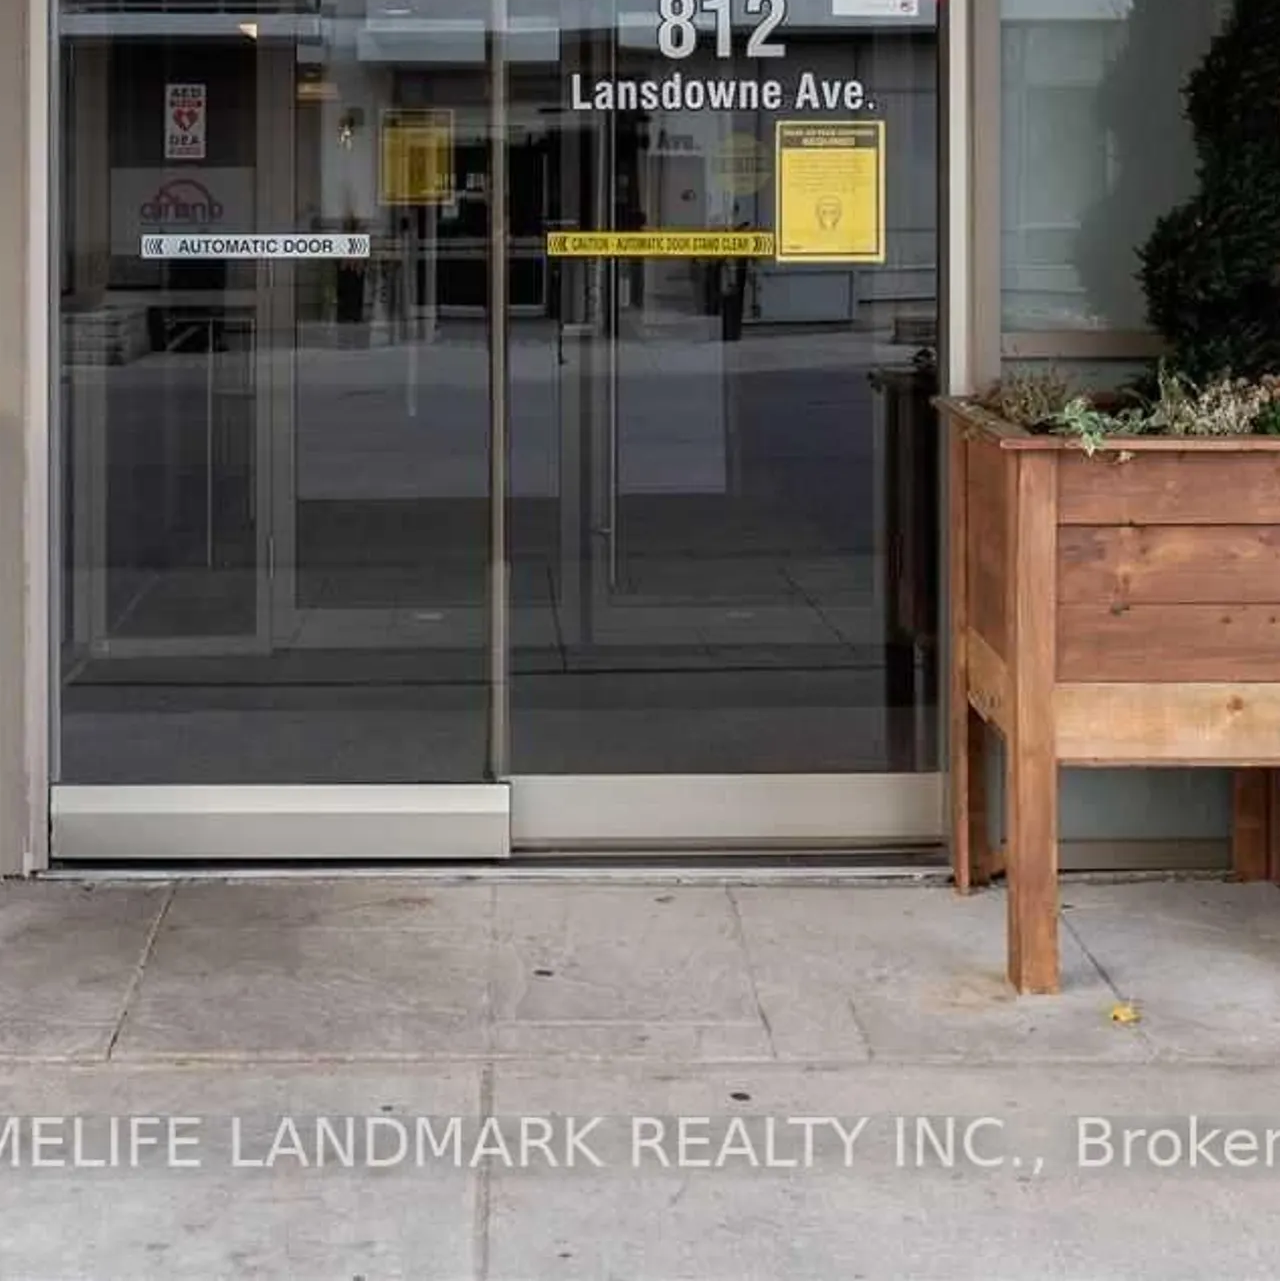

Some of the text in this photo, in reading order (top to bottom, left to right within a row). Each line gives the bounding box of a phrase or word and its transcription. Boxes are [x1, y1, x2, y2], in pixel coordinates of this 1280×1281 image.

[571, 72, 875, 111] Lansdowne Ave.
[178, 238, 334, 255] AUTOMATIC DOOR
